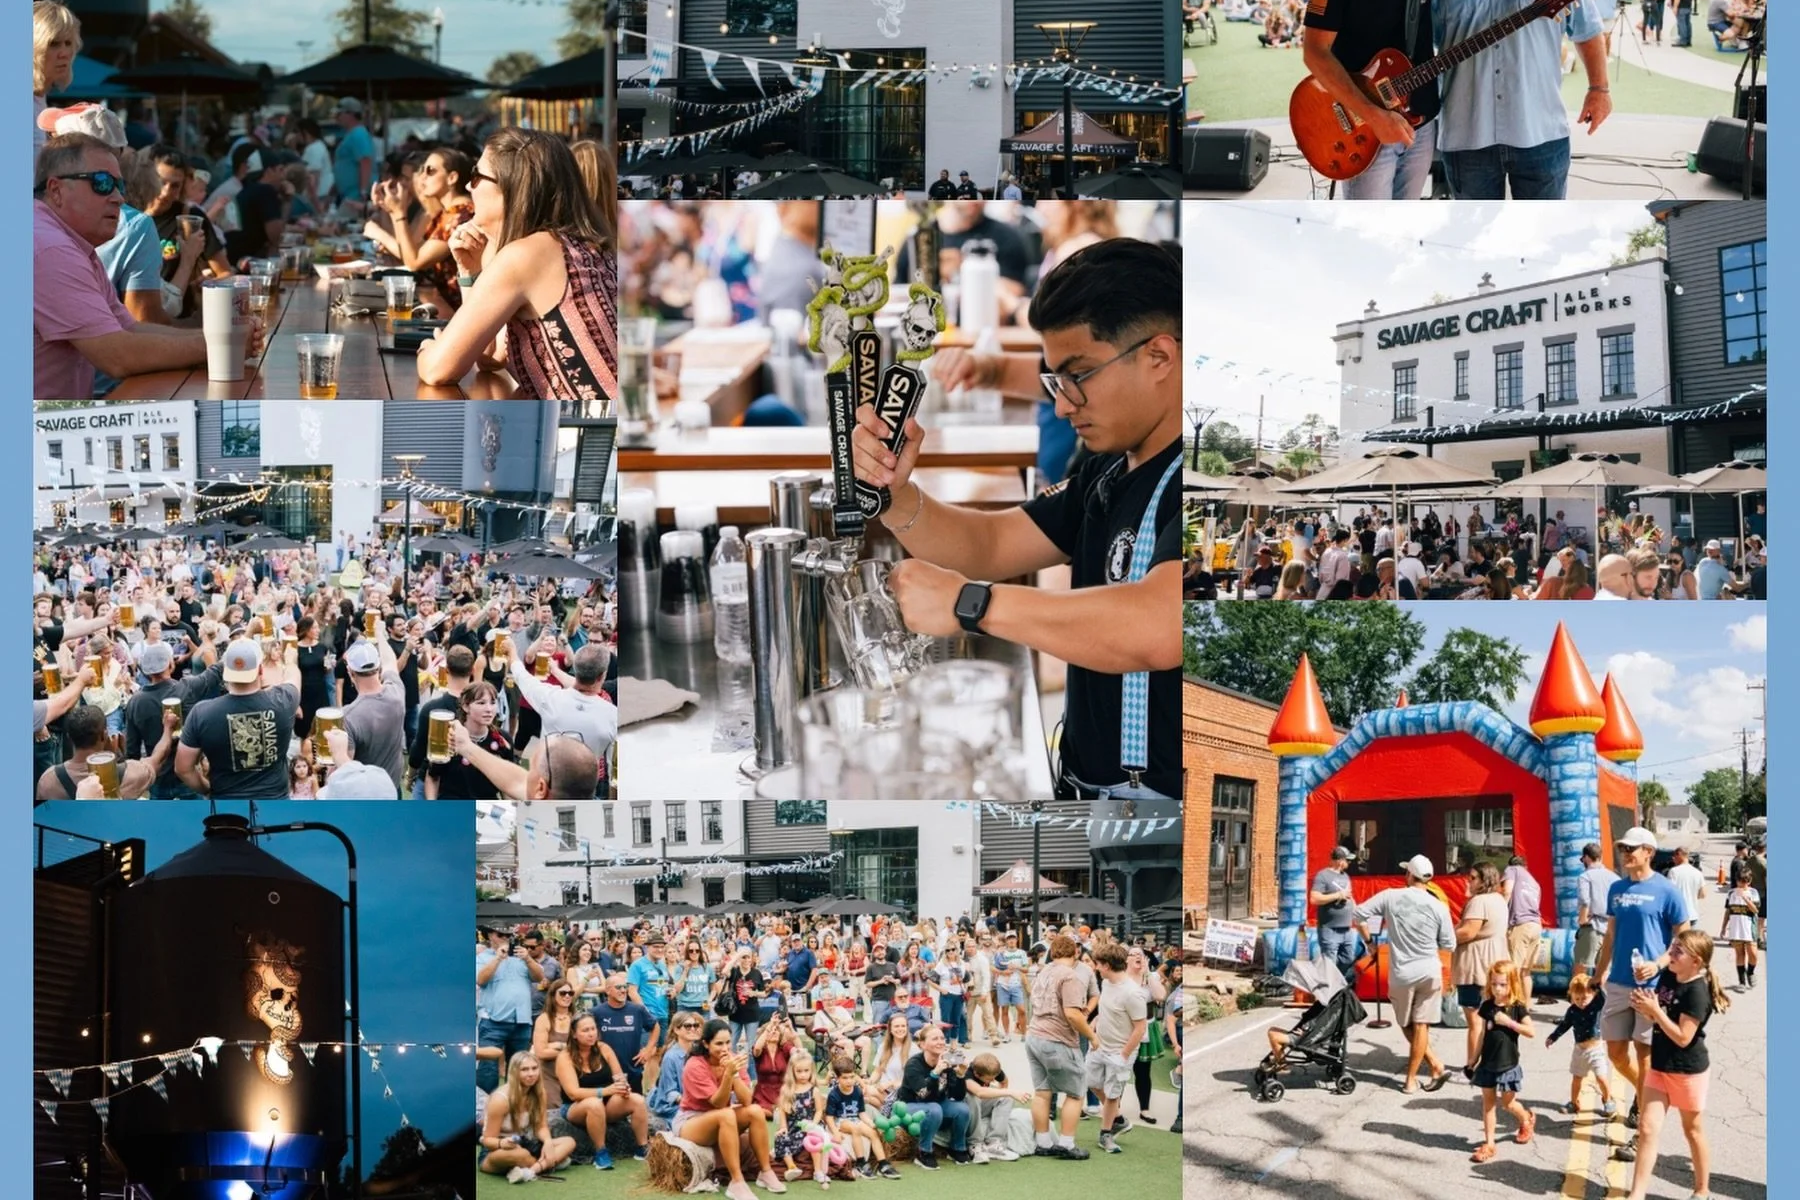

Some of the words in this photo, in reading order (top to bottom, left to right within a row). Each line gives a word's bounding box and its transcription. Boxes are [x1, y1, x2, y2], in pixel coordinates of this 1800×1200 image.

[1011, 142, 1054, 152] SAVAGE
[1056, 143, 1093, 153] CAFT
[1563, 295, 1632, 317] WORKS
[1564, 287, 1600, 303] ALE
[1377, 315, 1461, 350] SAVAGE
[1466, 298, 1547, 333] CRAFT
[861, 339, 875, 403] SAVA
[36, 416, 86, 433] SAVAGE
[89, 413, 134, 428] CRAFT
[834, 390, 846, 433] SAVAGE
[838, 434, 849, 470] CRAFT
[263, 709, 278, 767] SAVAGE
